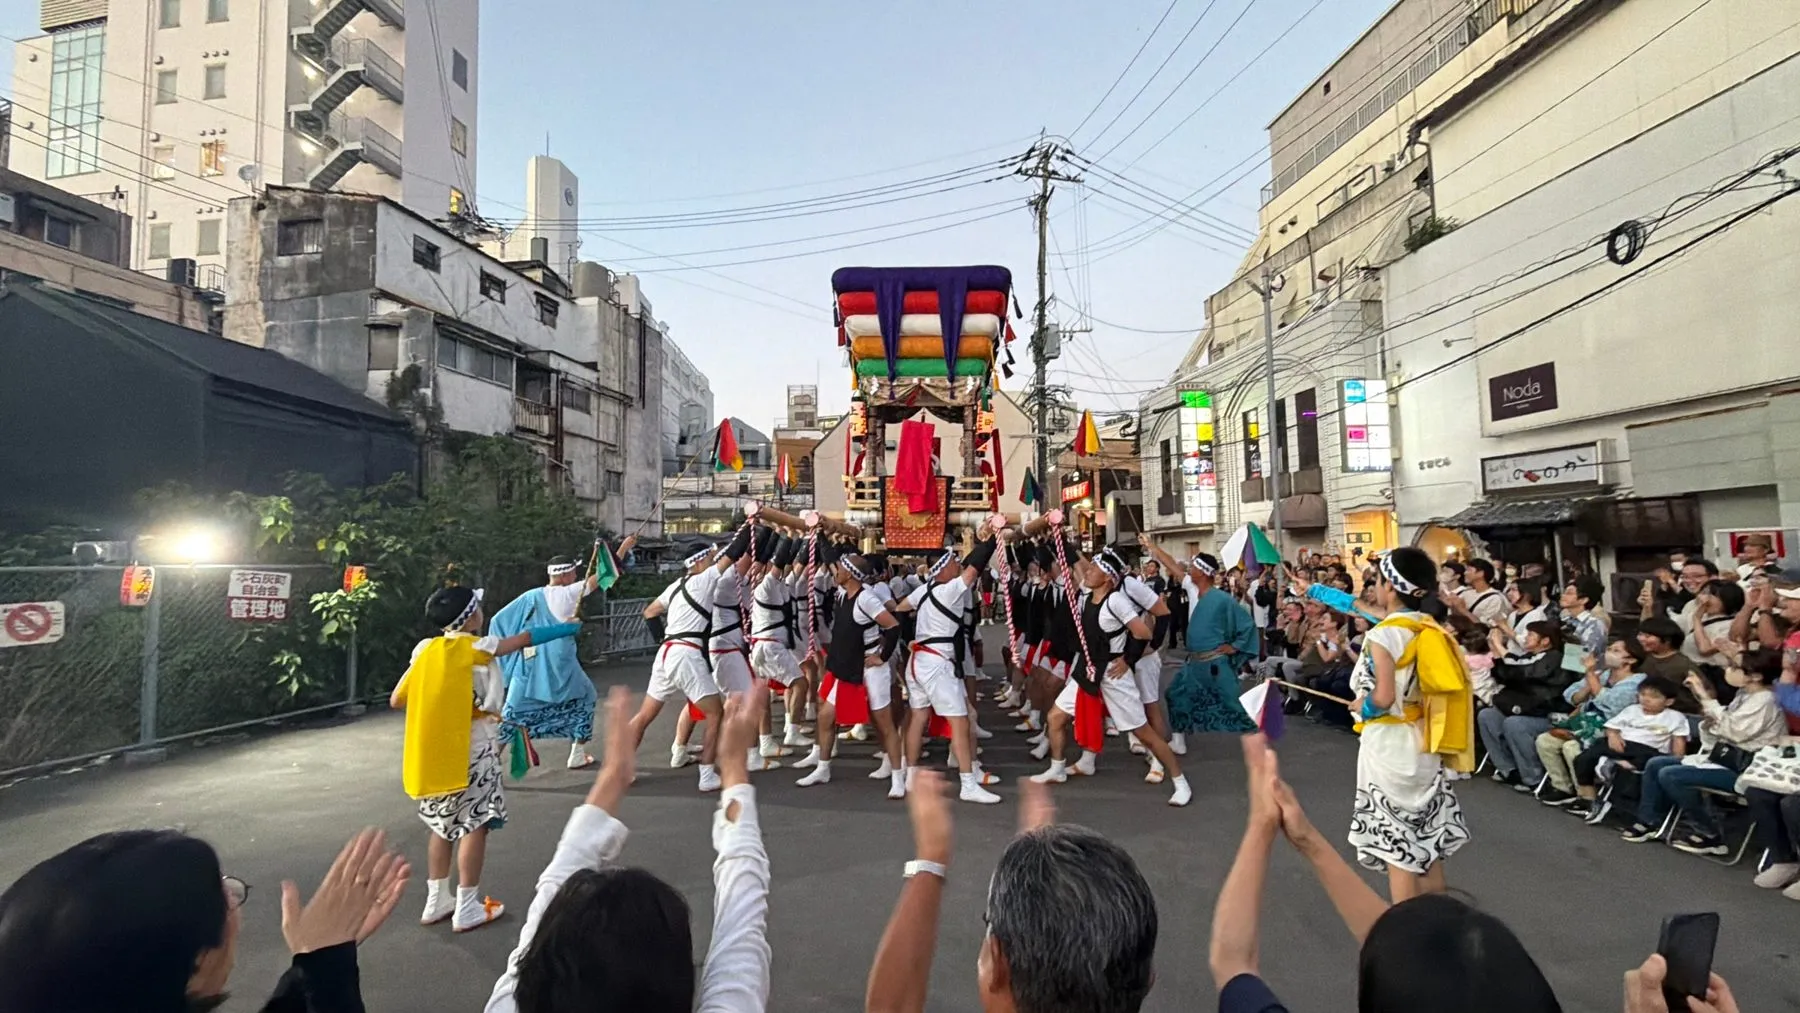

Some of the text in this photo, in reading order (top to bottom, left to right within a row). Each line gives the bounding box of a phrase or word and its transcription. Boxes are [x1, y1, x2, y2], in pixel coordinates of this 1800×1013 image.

[1503, 376, 1541, 402] Noda
[242, 584, 280, 596] 自治会
[230, 598, 286, 619] 管理地
